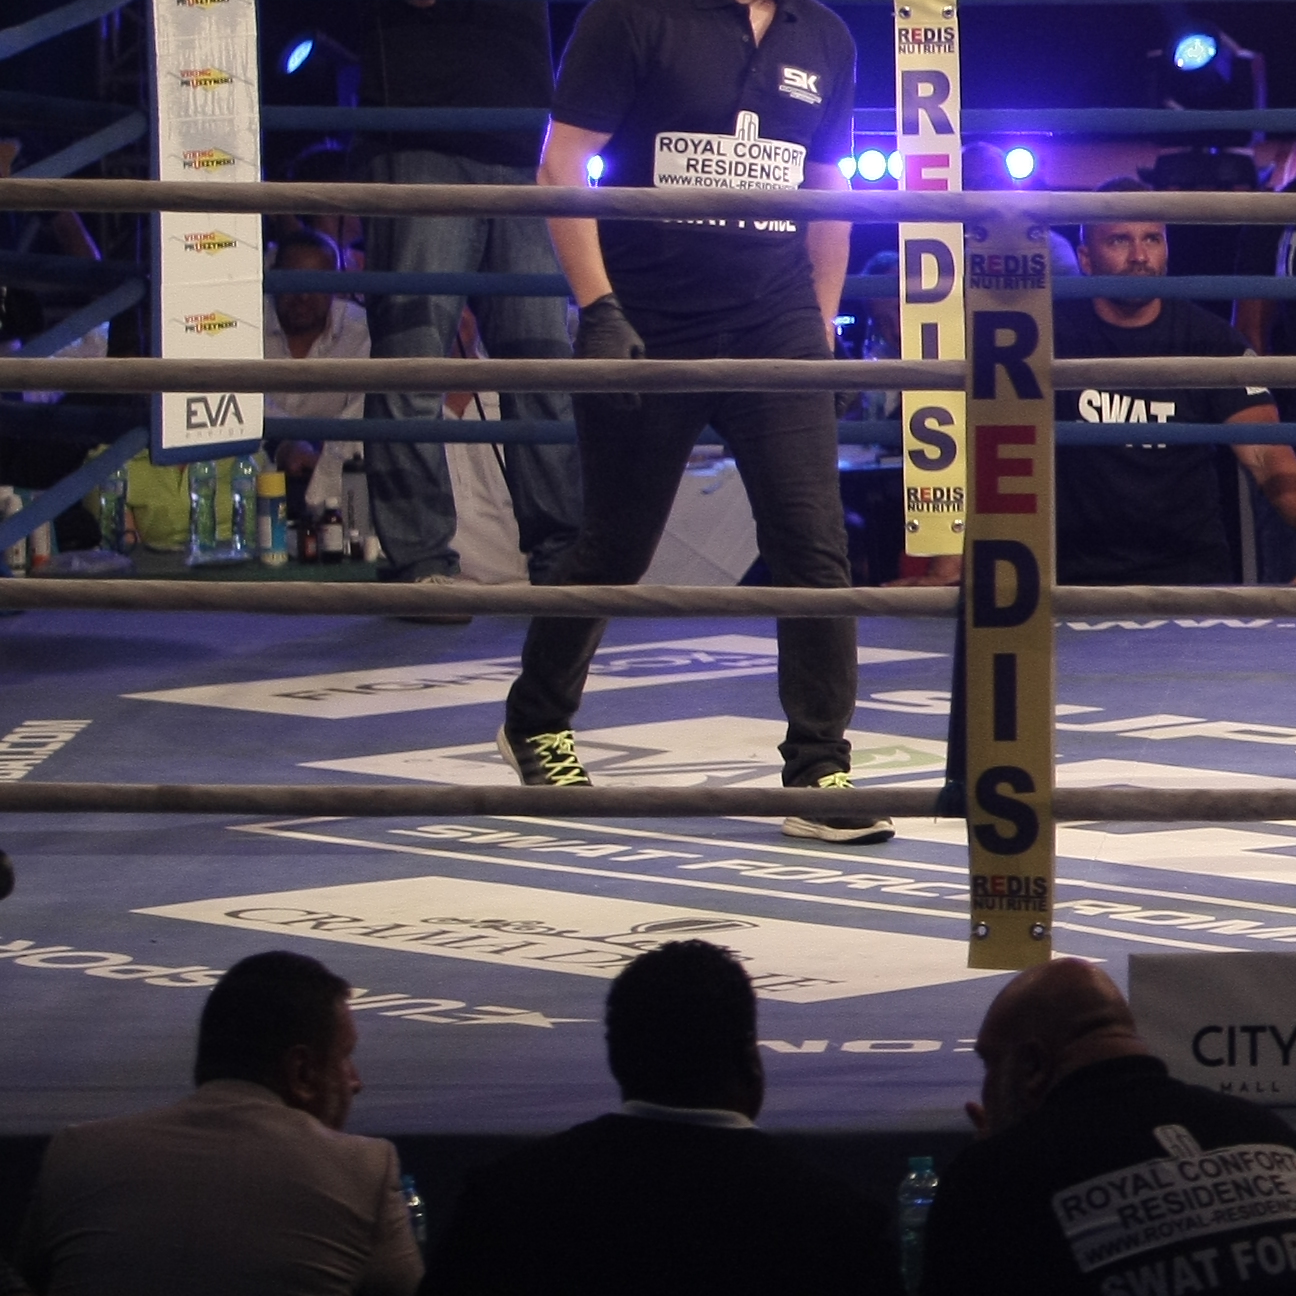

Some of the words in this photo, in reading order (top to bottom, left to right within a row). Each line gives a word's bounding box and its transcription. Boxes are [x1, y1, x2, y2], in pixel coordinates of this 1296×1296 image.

[898, 27, 956, 42] REDIS
[180, 68, 211, 78] VIKING
[183, 149, 214, 159] VIKING
[659, 136, 728, 157] ROYAL
[733, 141, 804, 167] CONFORT
[686, 158, 790, 182] RESIDENCE
[184, 232, 216, 241] VIKING
[970, 254, 1047, 275] REDIS
[970, 276, 1046, 290] NUTRITIE
[184, 313, 216, 323] VIKING
[186, 394, 245, 431] EVA
[907, 486, 964, 502] REDIS
[388, 824, 704, 864] SWAT
[679, 857, 970, 902] FORC
[972, 876, 1048, 896] REDIS
[224, 907, 546, 955] CRAMA
[1219, 1080, 1281, 1093] MALL
[1060, 1167, 1174, 1223] ROYAL
[1116, 1174, 1291, 1229] RESIDENCE
[1101, 1247, 1221, 1296] SWAT
